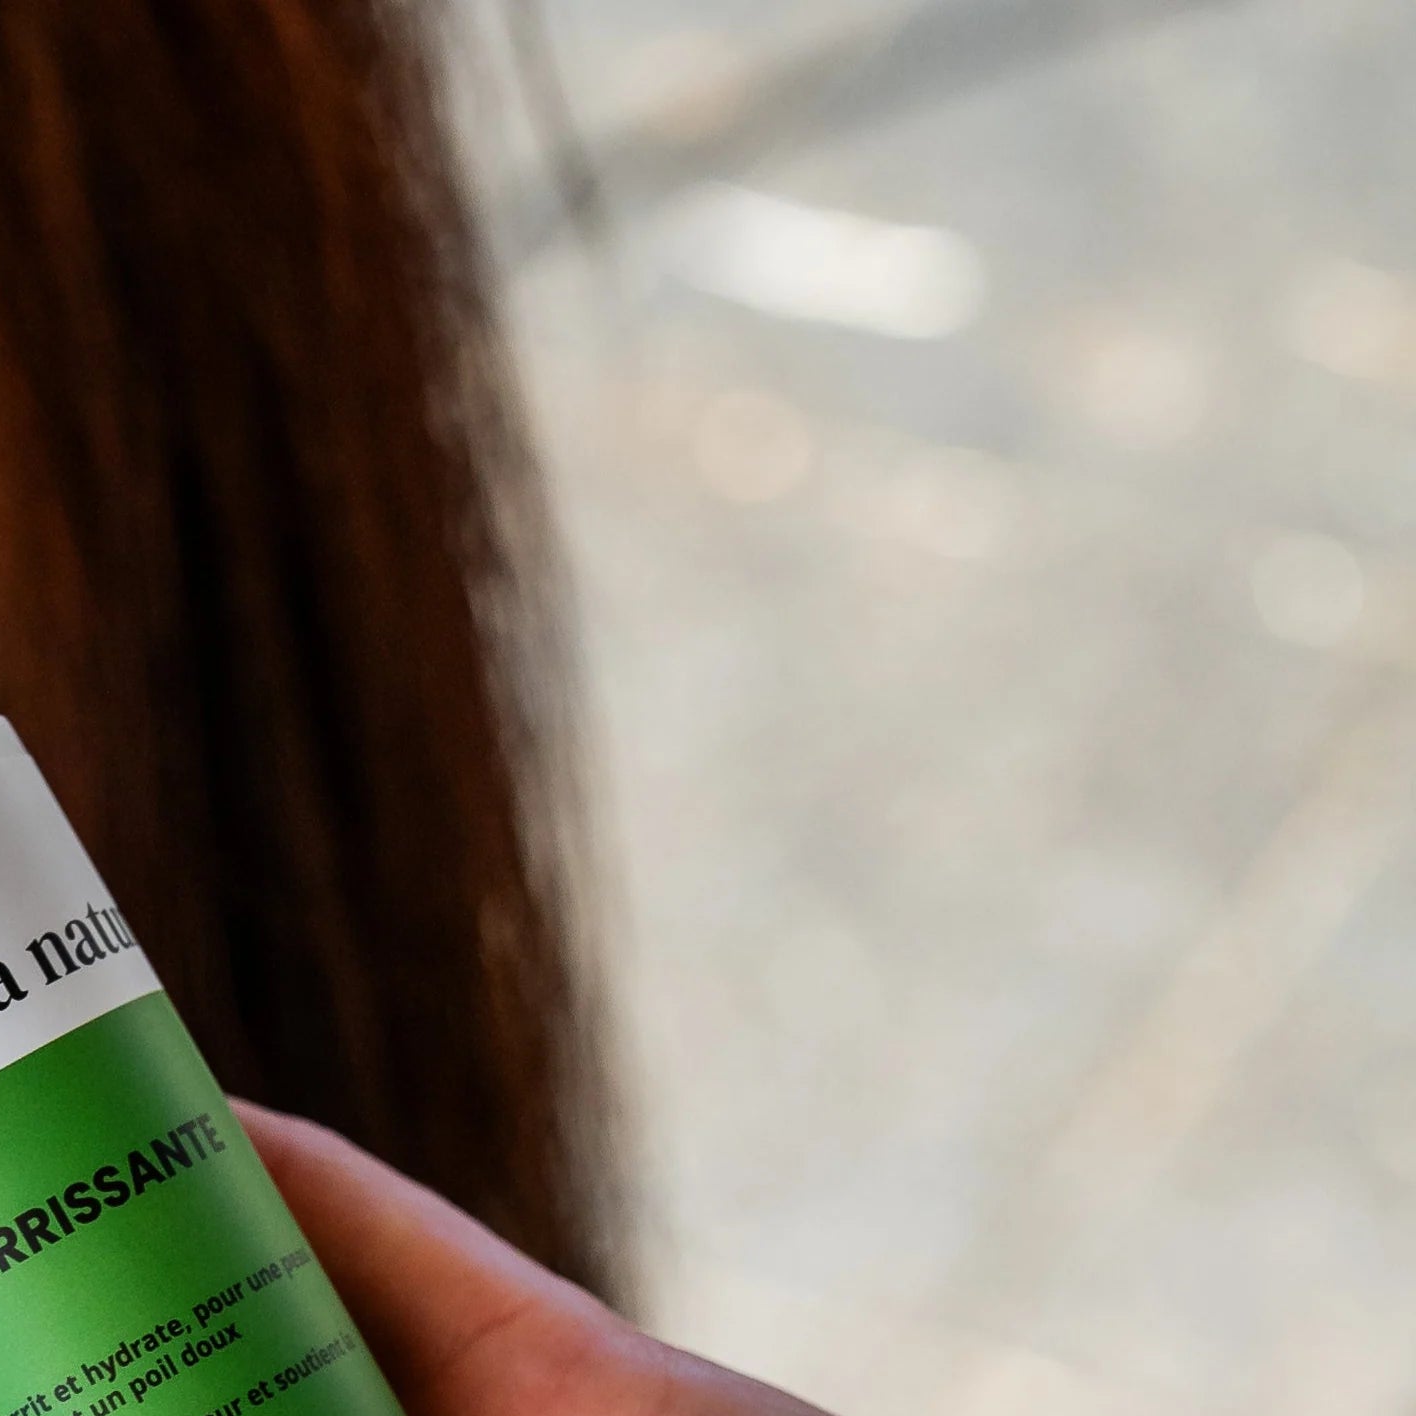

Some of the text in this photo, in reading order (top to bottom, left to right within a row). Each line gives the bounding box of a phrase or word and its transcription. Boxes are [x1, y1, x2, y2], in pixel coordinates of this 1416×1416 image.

[54, 1375, 84, 1403] et
[81, 1312, 193, 1386] hydrate,
[193, 1281, 245, 1326] pour
[246, 1263, 282, 1293] une
[129, 1354, 180, 1404] poil
[181, 1322, 243, 1369] doux
[247, 1380, 276, 1407] et
[274, 1338, 346, 1391] soutient
